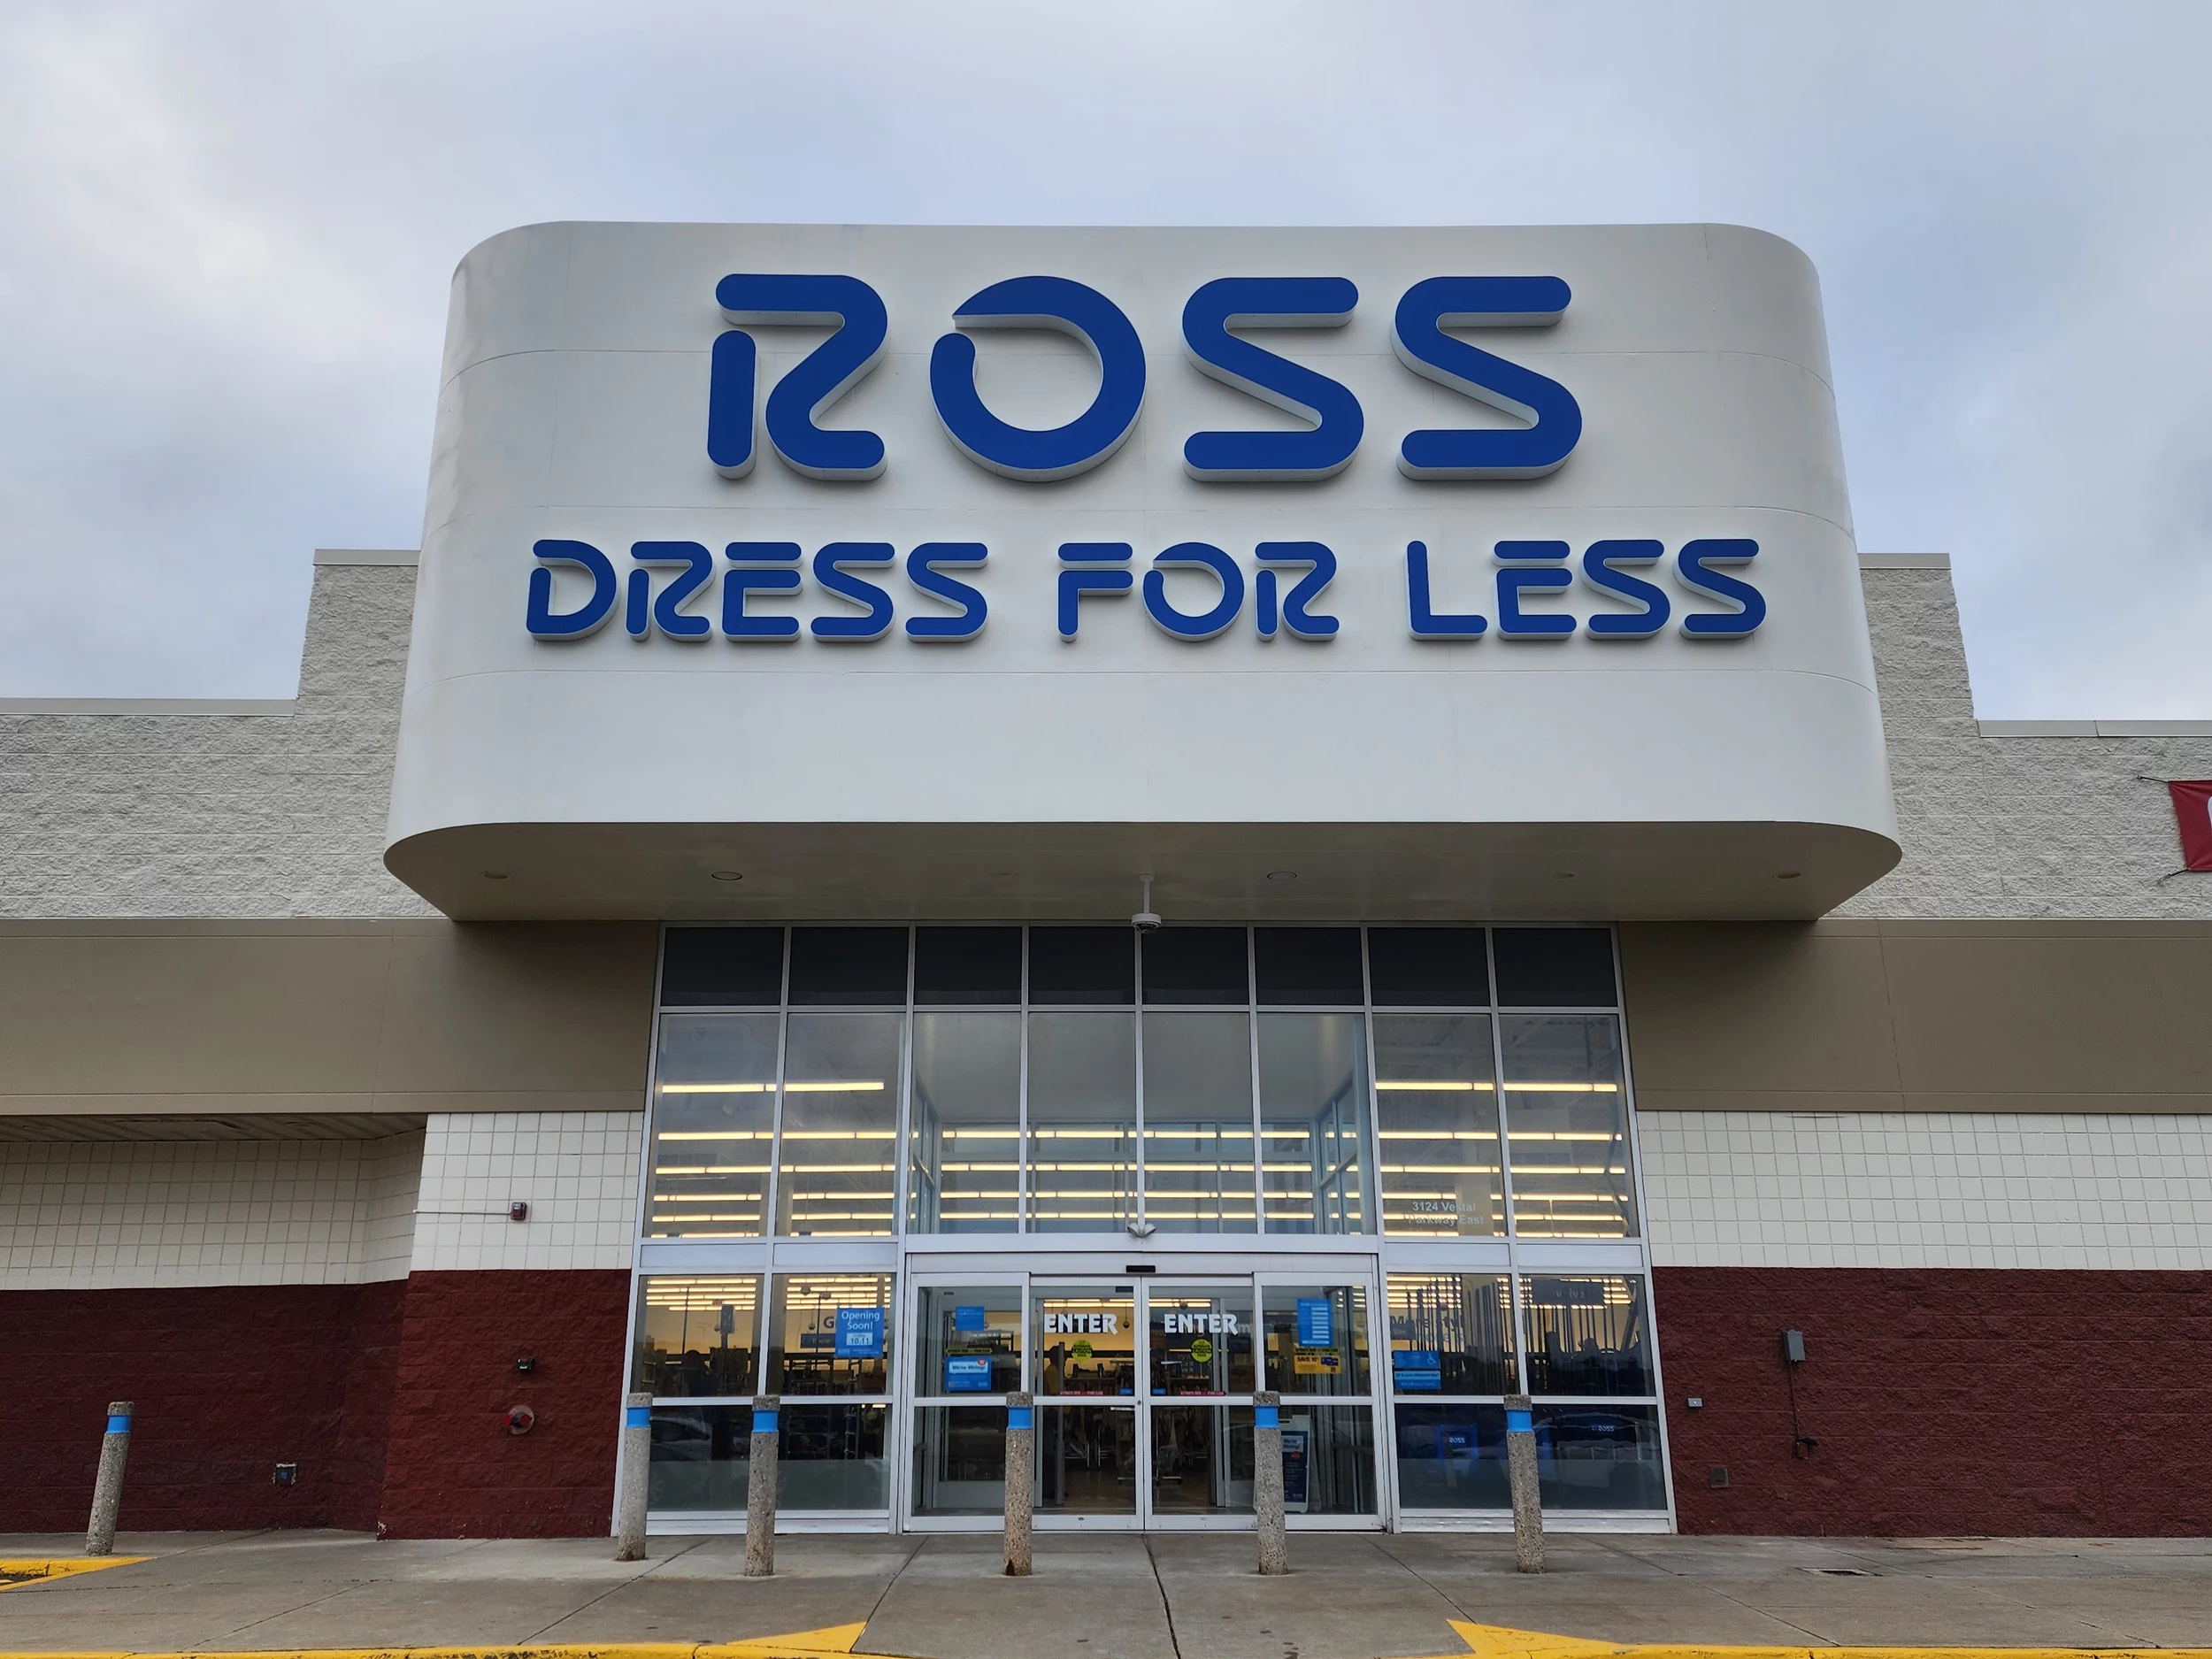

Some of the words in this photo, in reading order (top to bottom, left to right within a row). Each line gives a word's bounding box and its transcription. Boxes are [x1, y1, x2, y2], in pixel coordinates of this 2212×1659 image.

[708, 274, 1582, 470] ROSS
[526, 540, 988, 636] DRESS
[1058, 541, 1340, 636] FOR
[1408, 539, 1766, 635] LESS
[1412, 1202, 1439, 1211] 3124
[1441, 1202, 1476, 1211] Vestal
[1459, 1215, 1484, 1225] East
[841, 1310, 880, 1322] Opening
[1044, 1313, 1118, 1335] ENTER
[1164, 1313, 1239, 1335] ENTER
[847, 1321, 873, 1330] Soon!
